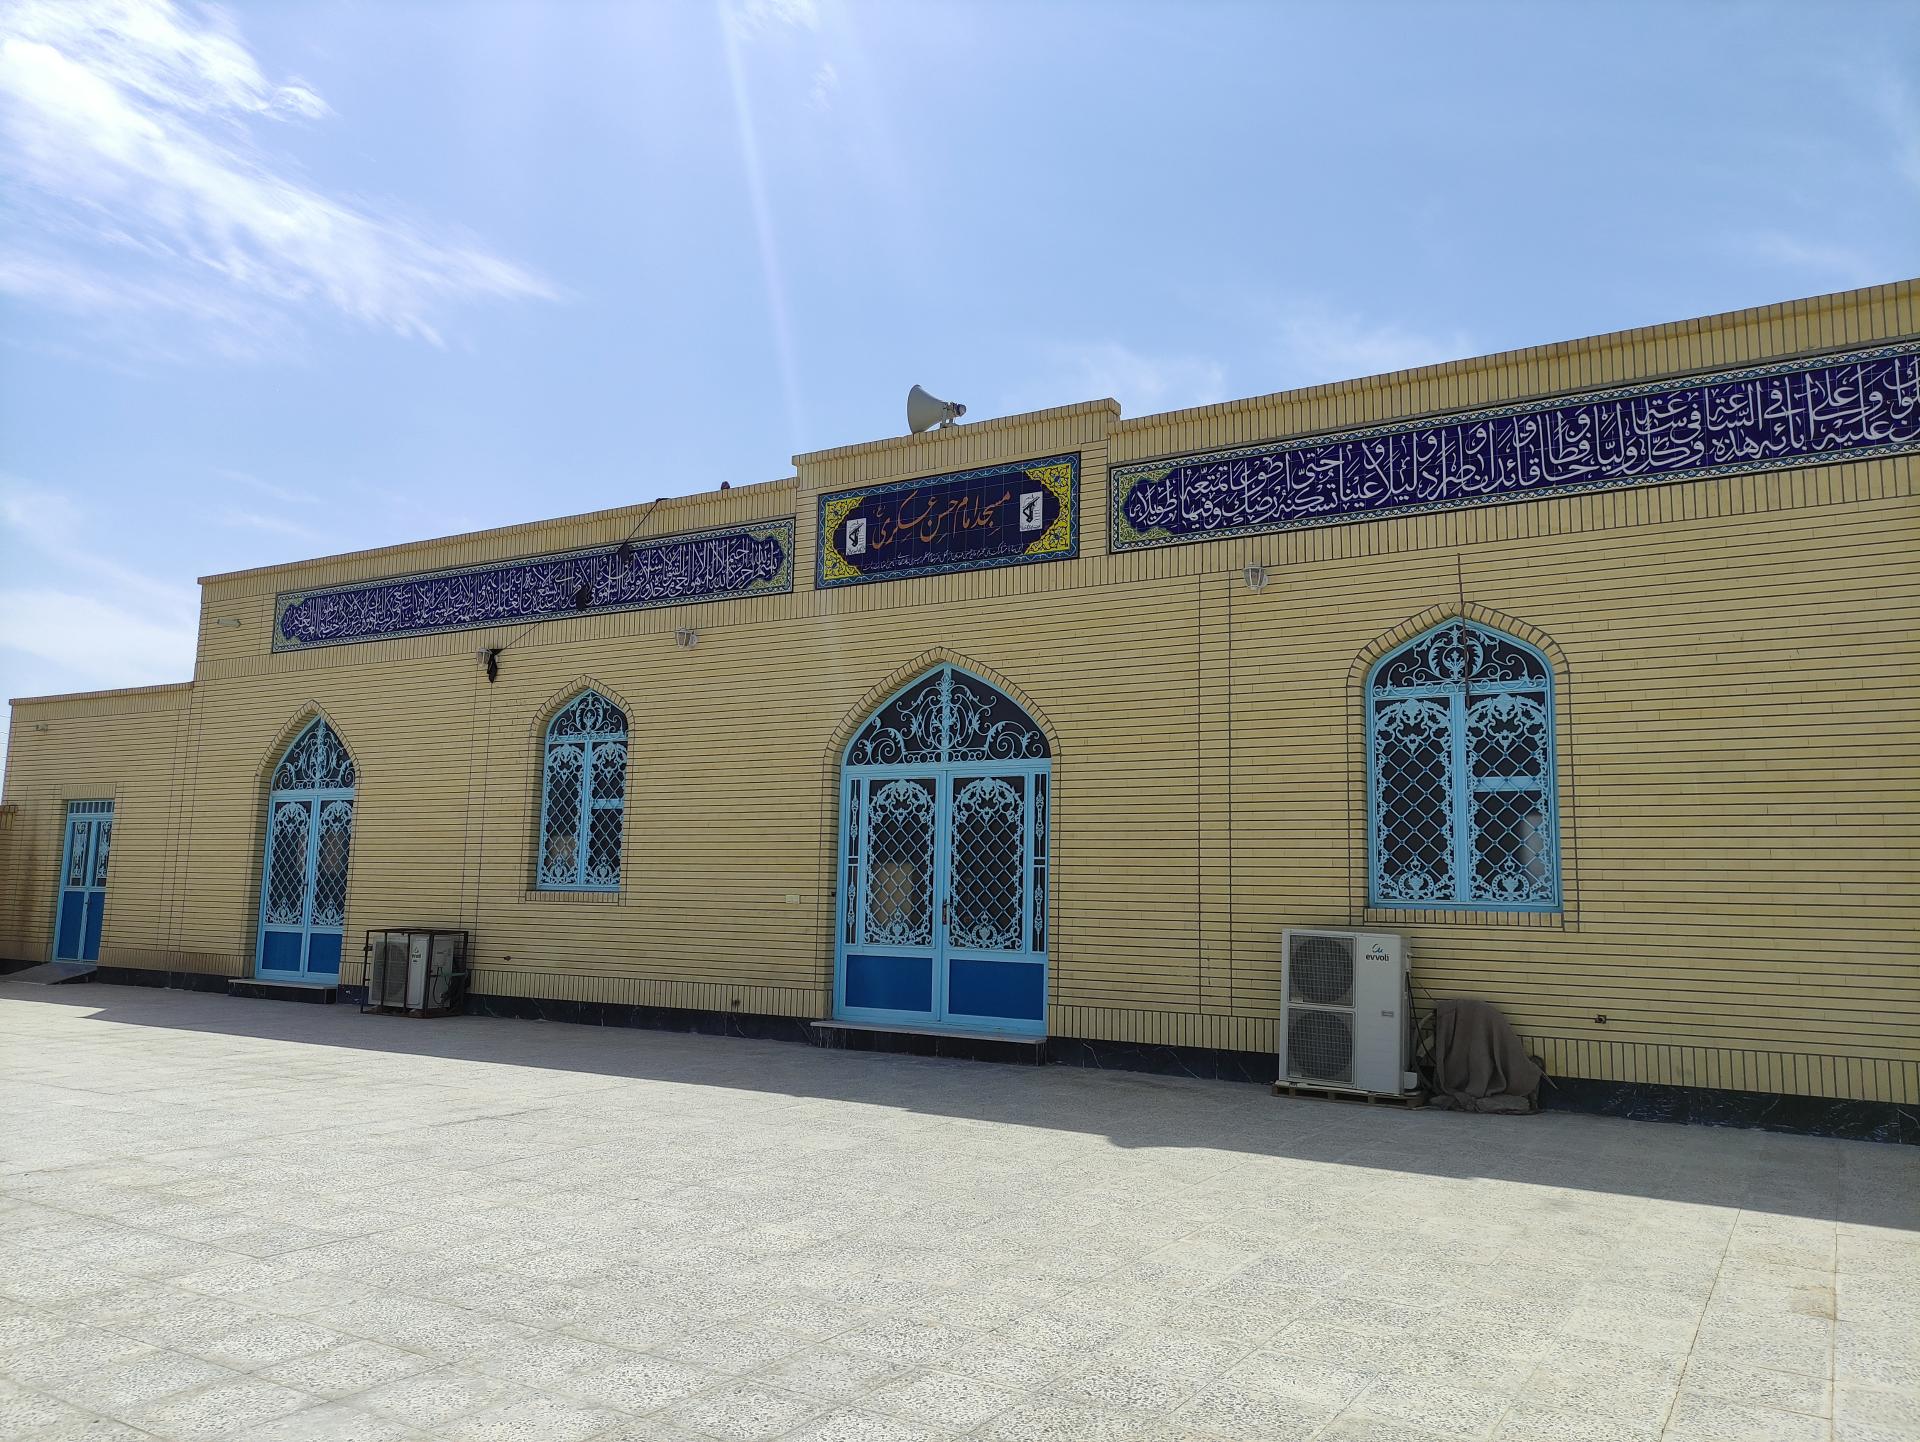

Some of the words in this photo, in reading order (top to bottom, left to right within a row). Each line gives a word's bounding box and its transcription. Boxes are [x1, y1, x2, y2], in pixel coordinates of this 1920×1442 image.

[920, 500, 960, 544] حسن
[970, 491, 1011, 529] مسجد
[1365, 953, 1390, 961] evvoli
